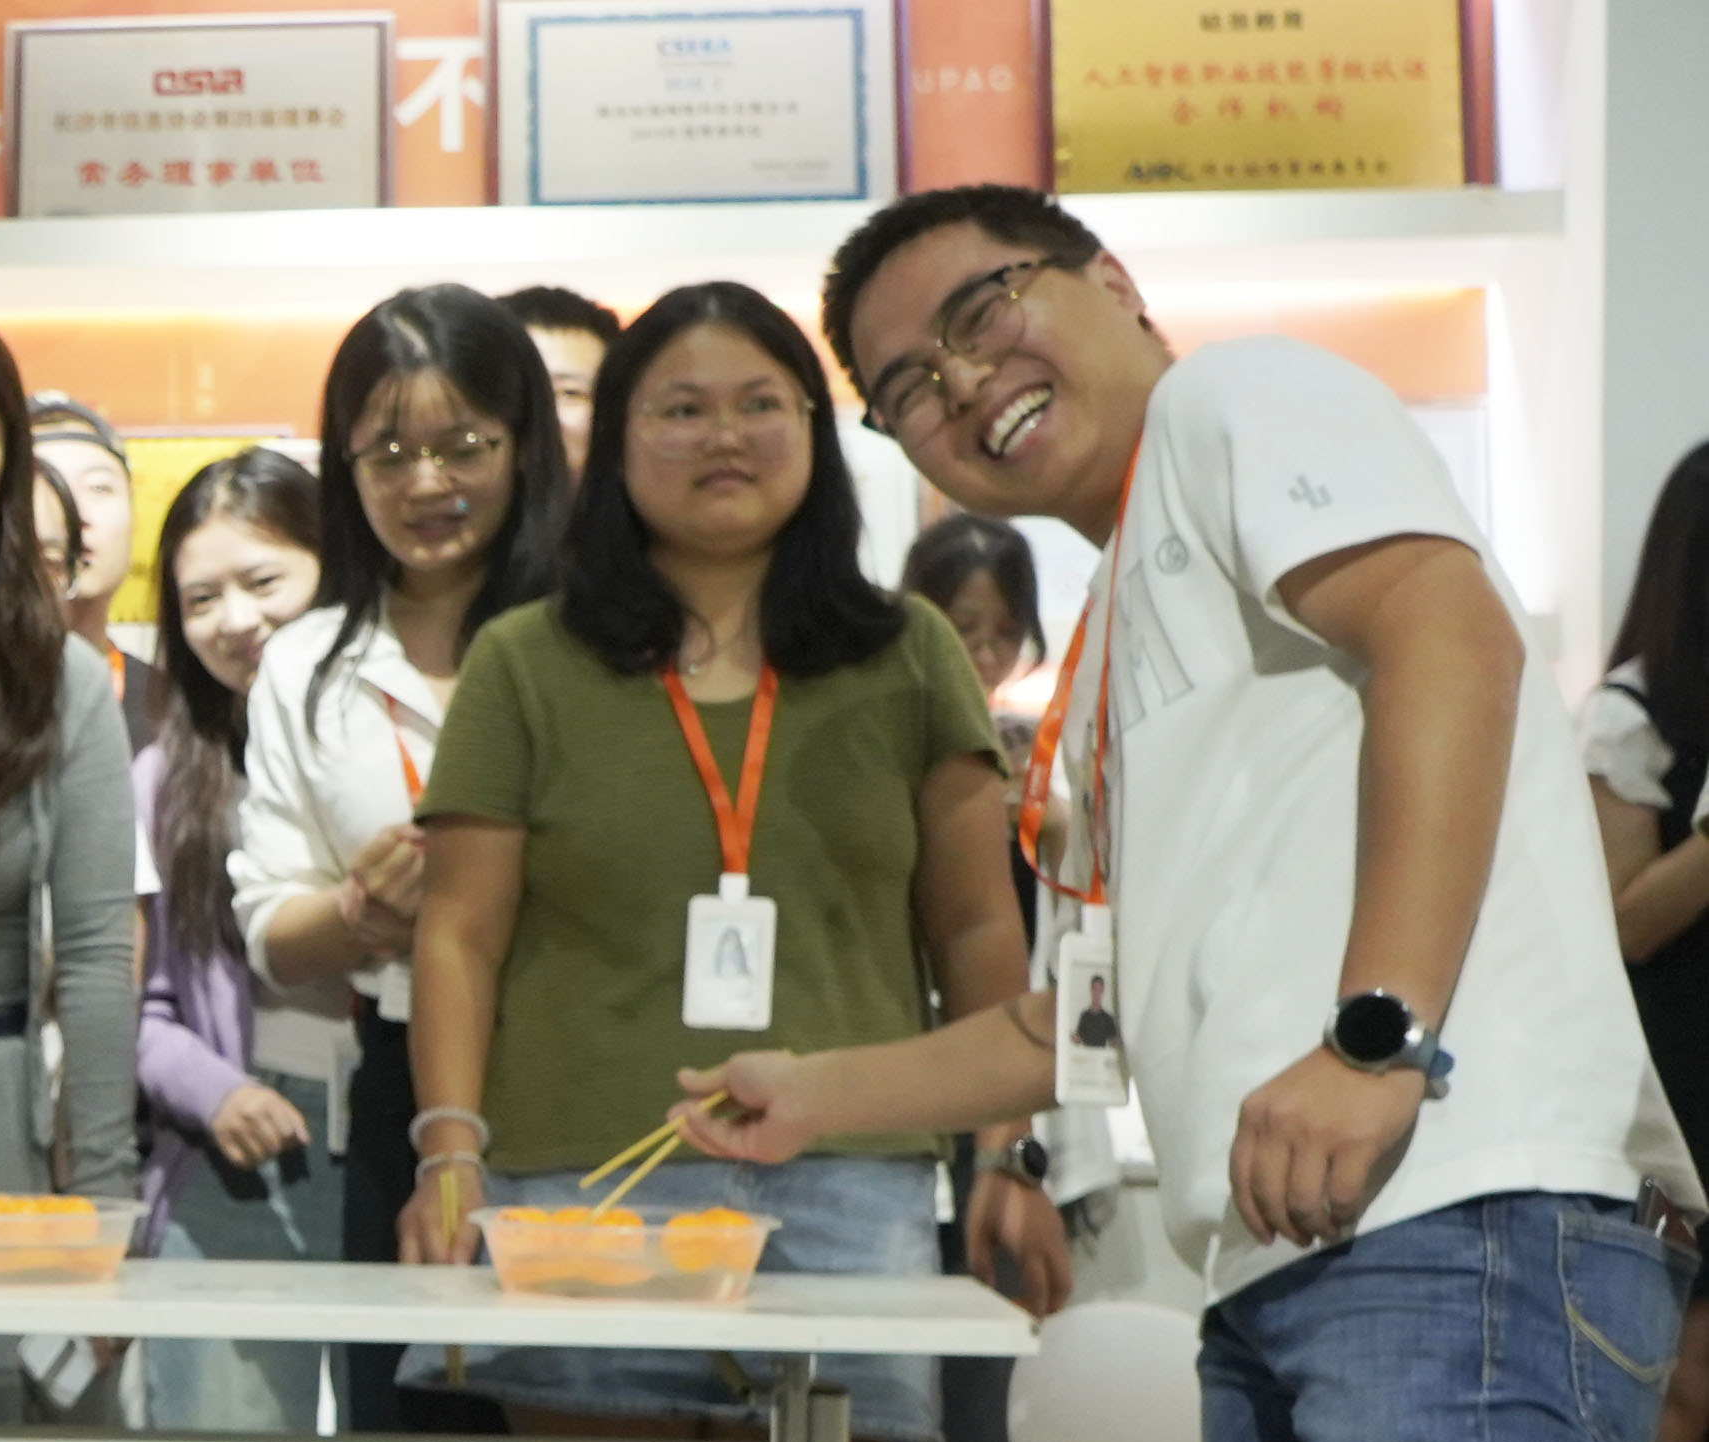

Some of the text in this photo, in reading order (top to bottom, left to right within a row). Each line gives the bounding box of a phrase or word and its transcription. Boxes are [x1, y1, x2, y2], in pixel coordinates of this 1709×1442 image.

[77, 159, 327, 188] 常务理事单位
